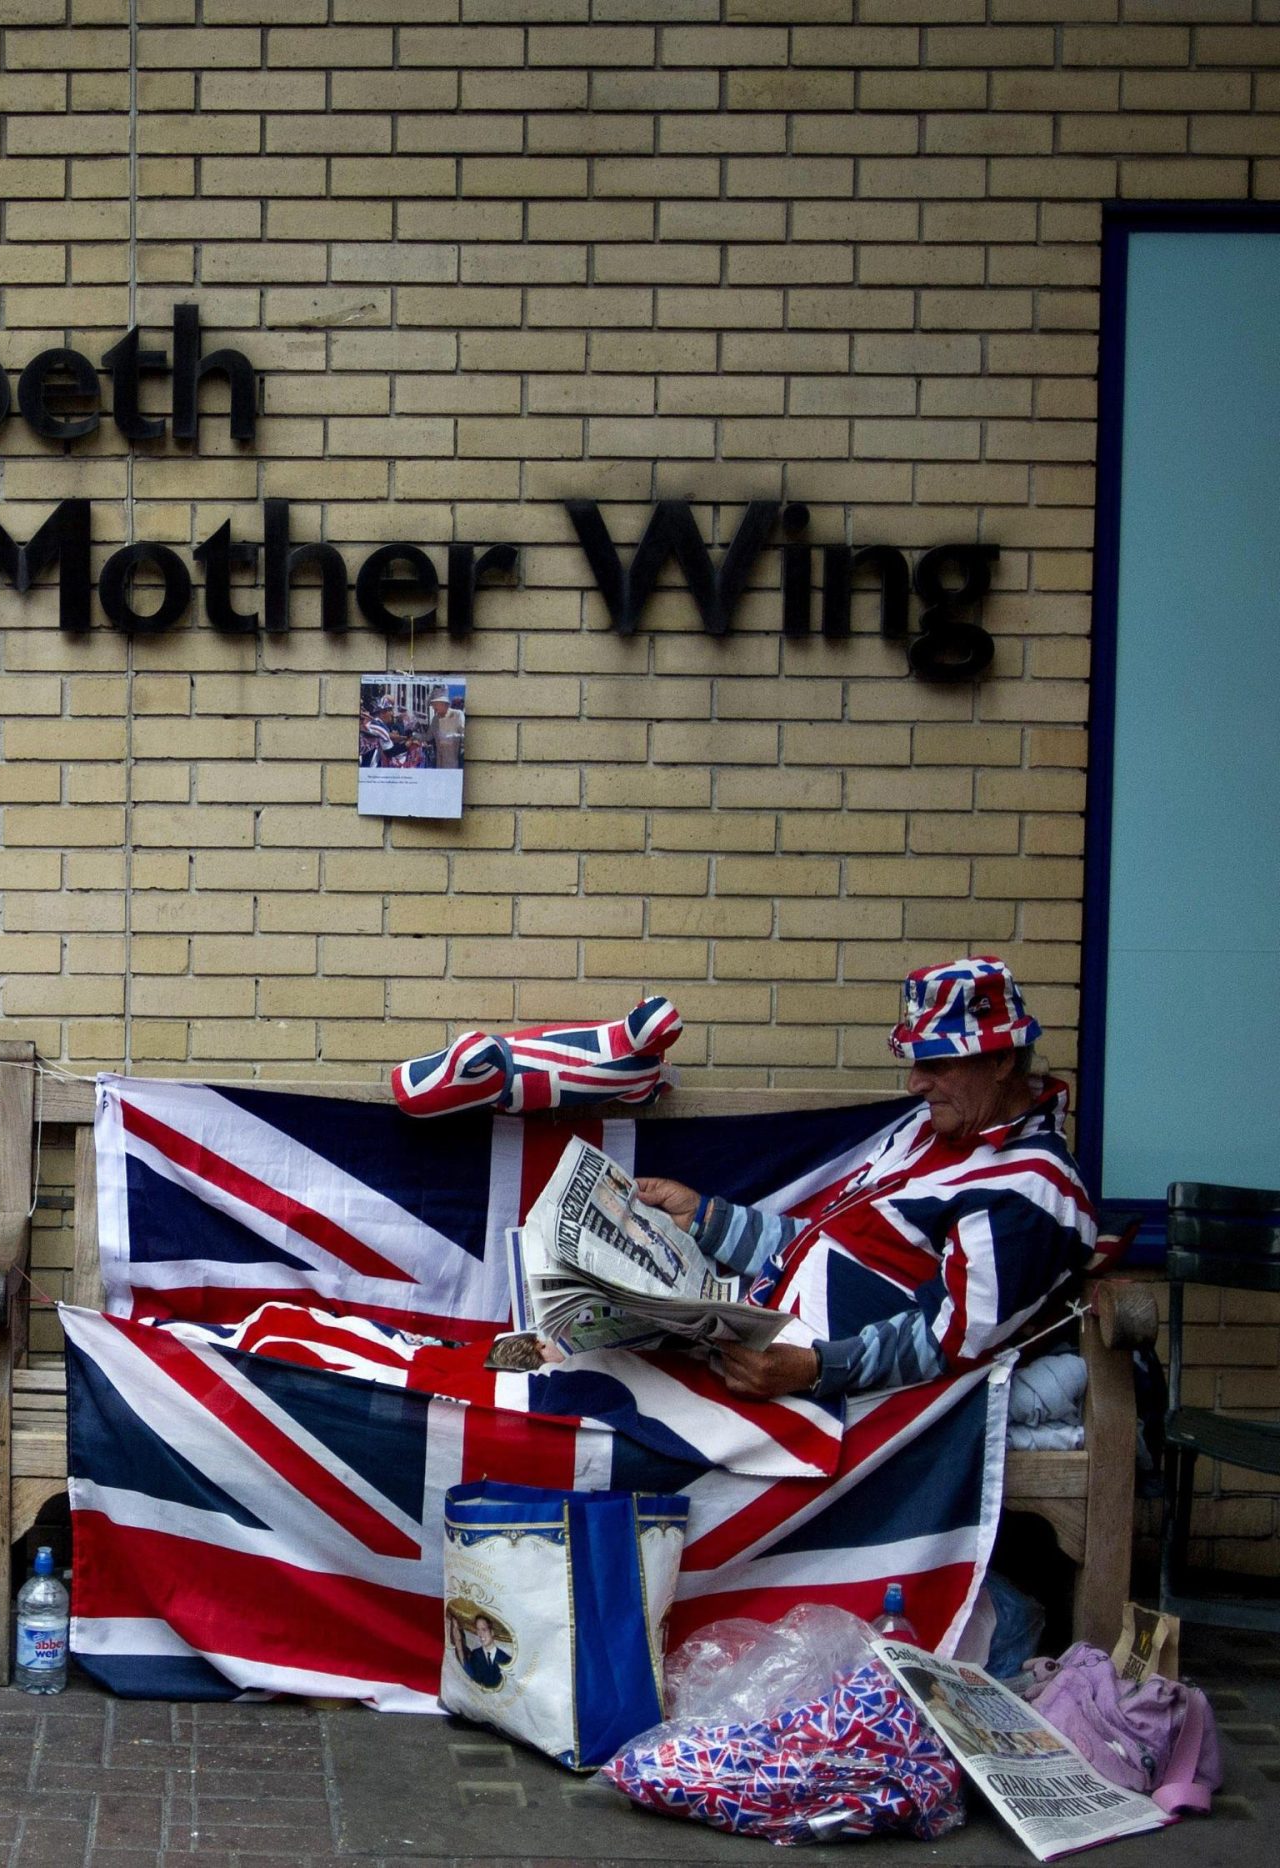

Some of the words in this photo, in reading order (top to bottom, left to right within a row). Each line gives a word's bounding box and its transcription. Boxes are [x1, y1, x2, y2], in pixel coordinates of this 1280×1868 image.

[565, 500, 1000, 678] Wing
[562, 1147, 606, 1221] GENERATION
[35, 1650, 59, 1659] well
[884, 1647, 925, 1667] Daily
[987, 1774, 1057, 1797] CHARLES
[1046, 1777, 1075, 1797] IN
[1065, 1774, 1107, 1795] NHS
[1003, 1797, 1099, 1821] HOMEOPATHY
[1086, 1790, 1131, 1809] ROW
